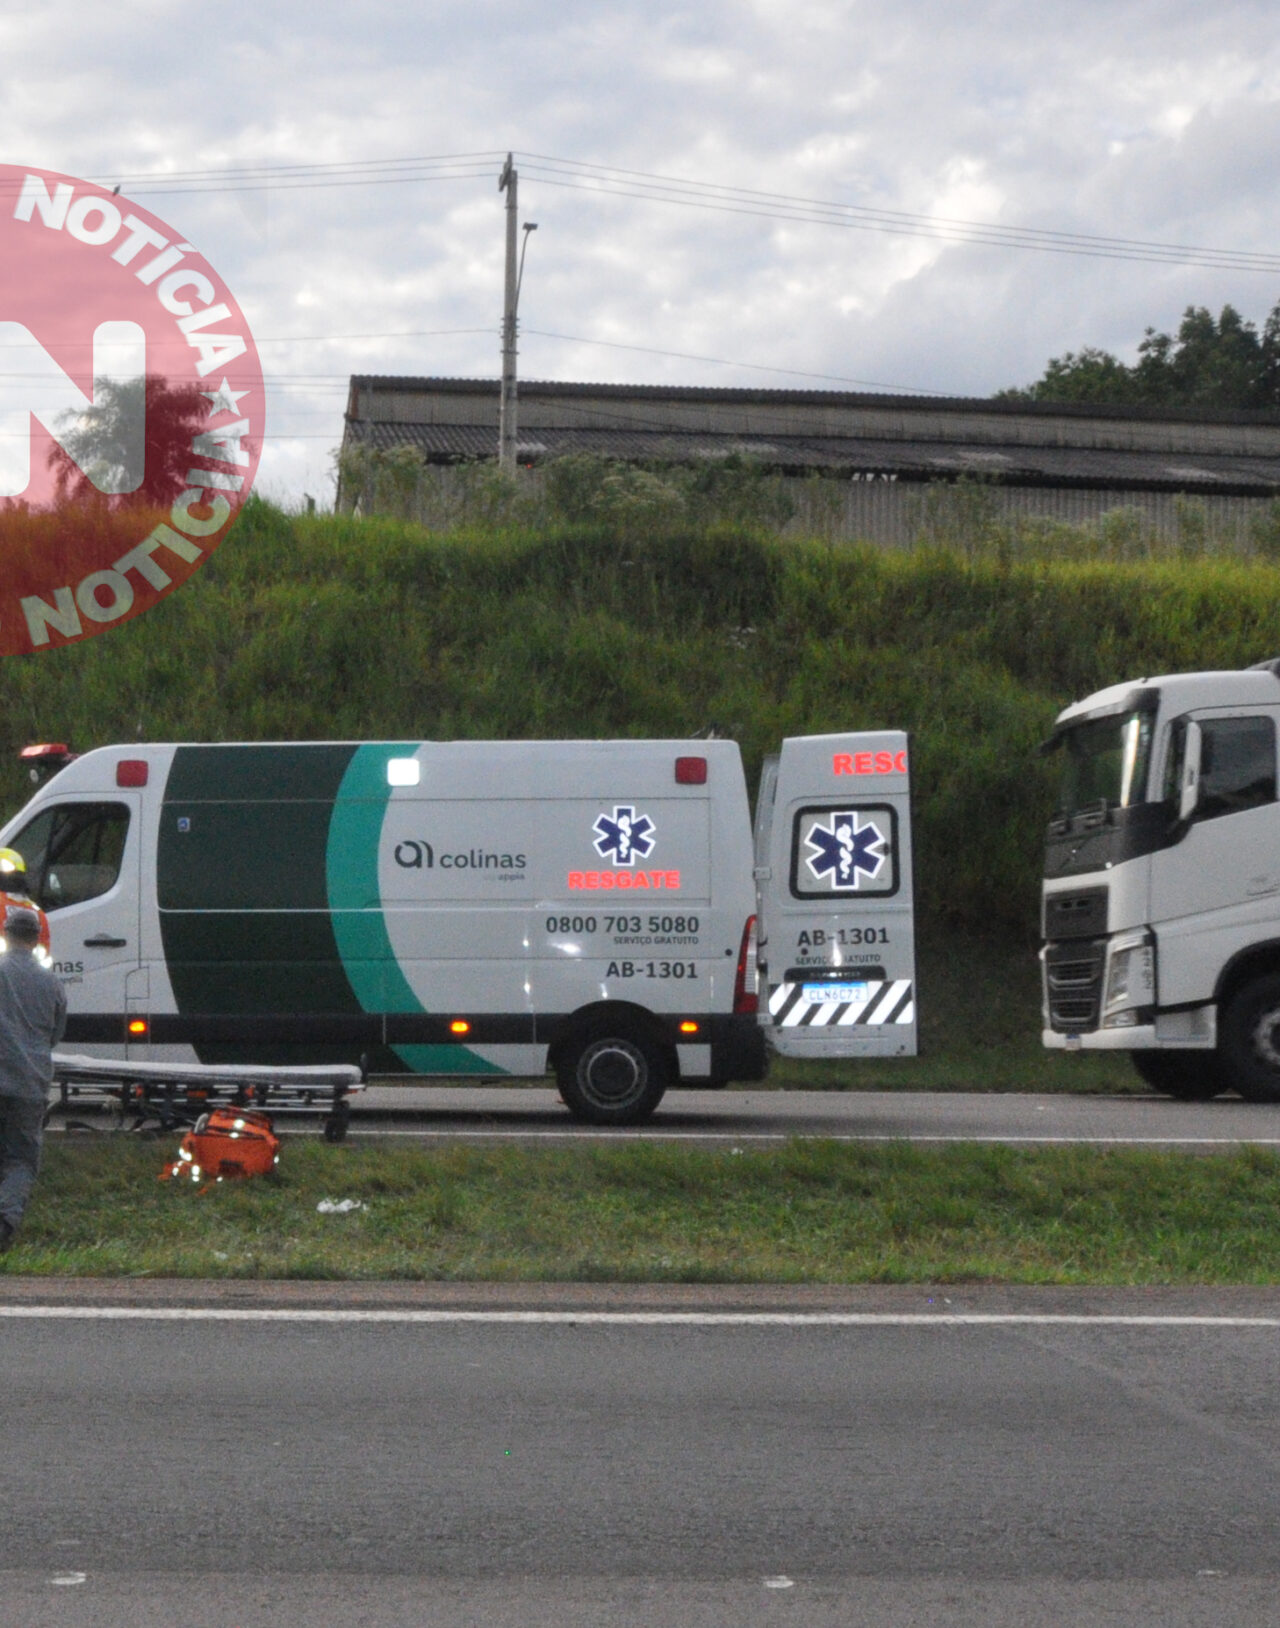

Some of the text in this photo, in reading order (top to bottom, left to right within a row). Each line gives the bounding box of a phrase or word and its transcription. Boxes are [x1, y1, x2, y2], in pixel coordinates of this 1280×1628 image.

[439, 848, 527, 869] colinas
[567, 870, 681, 890] RESGATE
[545, 916, 700, 933] 0800 703 5080
[613, 936, 699, 946] SERVIÇO GRATUITO
[797, 927, 890, 946] AB-1301
[606, 961, 699, 979] AB-1301
